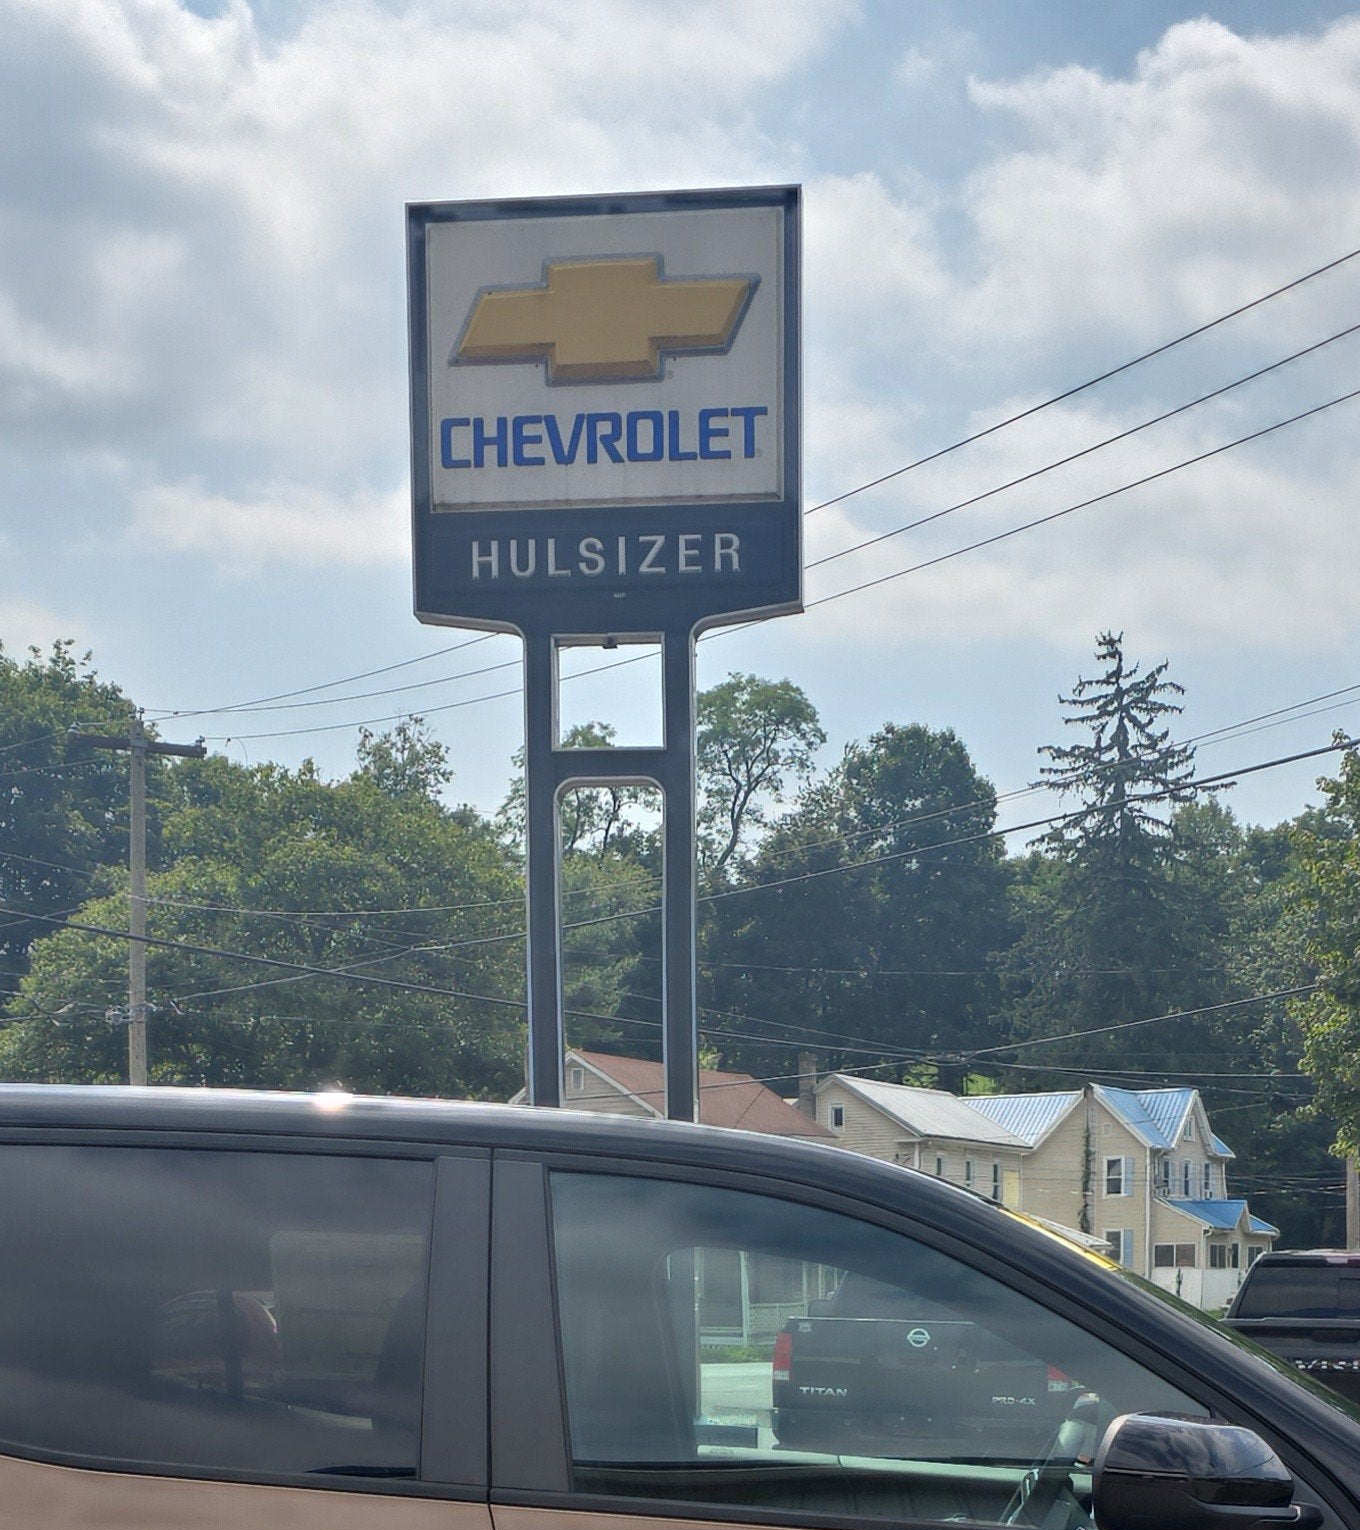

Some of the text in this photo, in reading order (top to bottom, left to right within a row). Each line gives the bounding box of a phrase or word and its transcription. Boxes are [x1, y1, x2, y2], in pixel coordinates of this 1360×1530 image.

[440, 406, 768, 470] CHEVROLET
[471, 532, 742, 580] HULSIZER
[799, 1386, 848, 1396] TITAN
